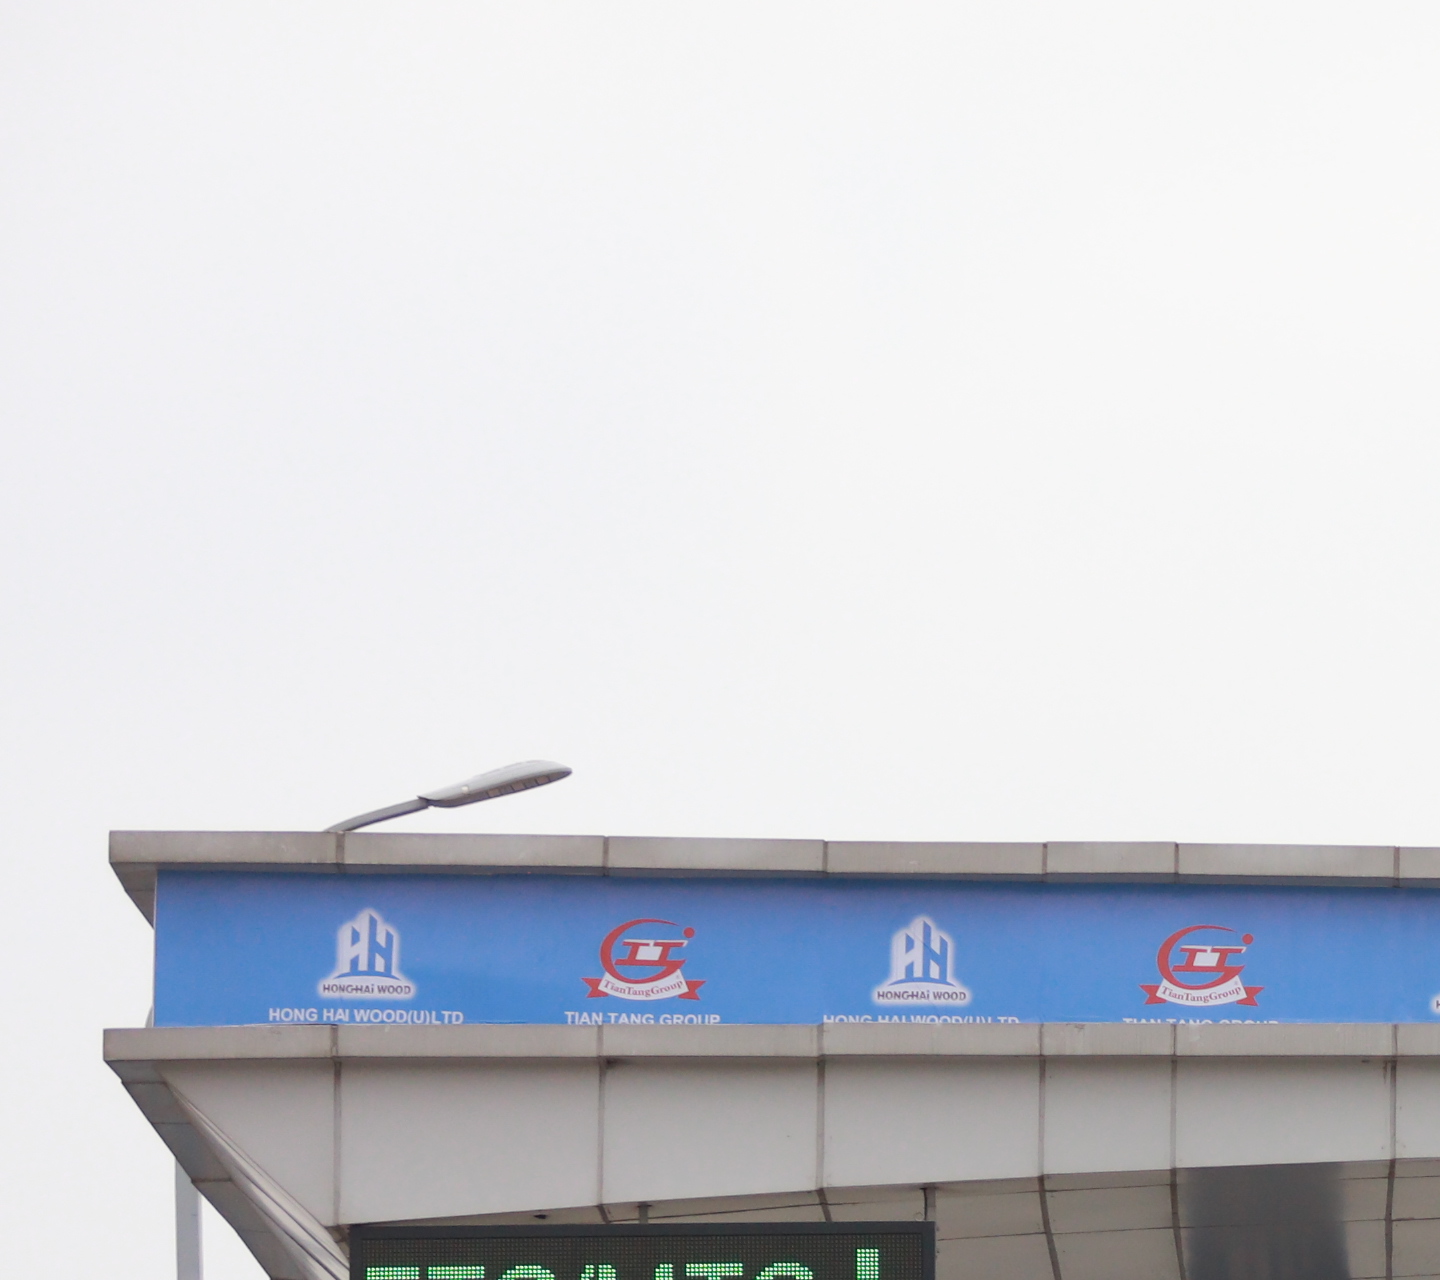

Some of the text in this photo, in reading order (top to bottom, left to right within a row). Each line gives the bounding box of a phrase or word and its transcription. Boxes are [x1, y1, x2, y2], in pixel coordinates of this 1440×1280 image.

[377, 984, 410, 995] WOOD
[602, 976, 685, 1000] TianTangGroup
[1161, 982, 1243, 1005] TianTangGroup
[933, 990, 966, 1002] WOOD
[269, 1008, 319, 1023] HONG
[323, 1009, 349, 1023] HAI
[564, 1011, 721, 1025] TIAN TANG GROUP
